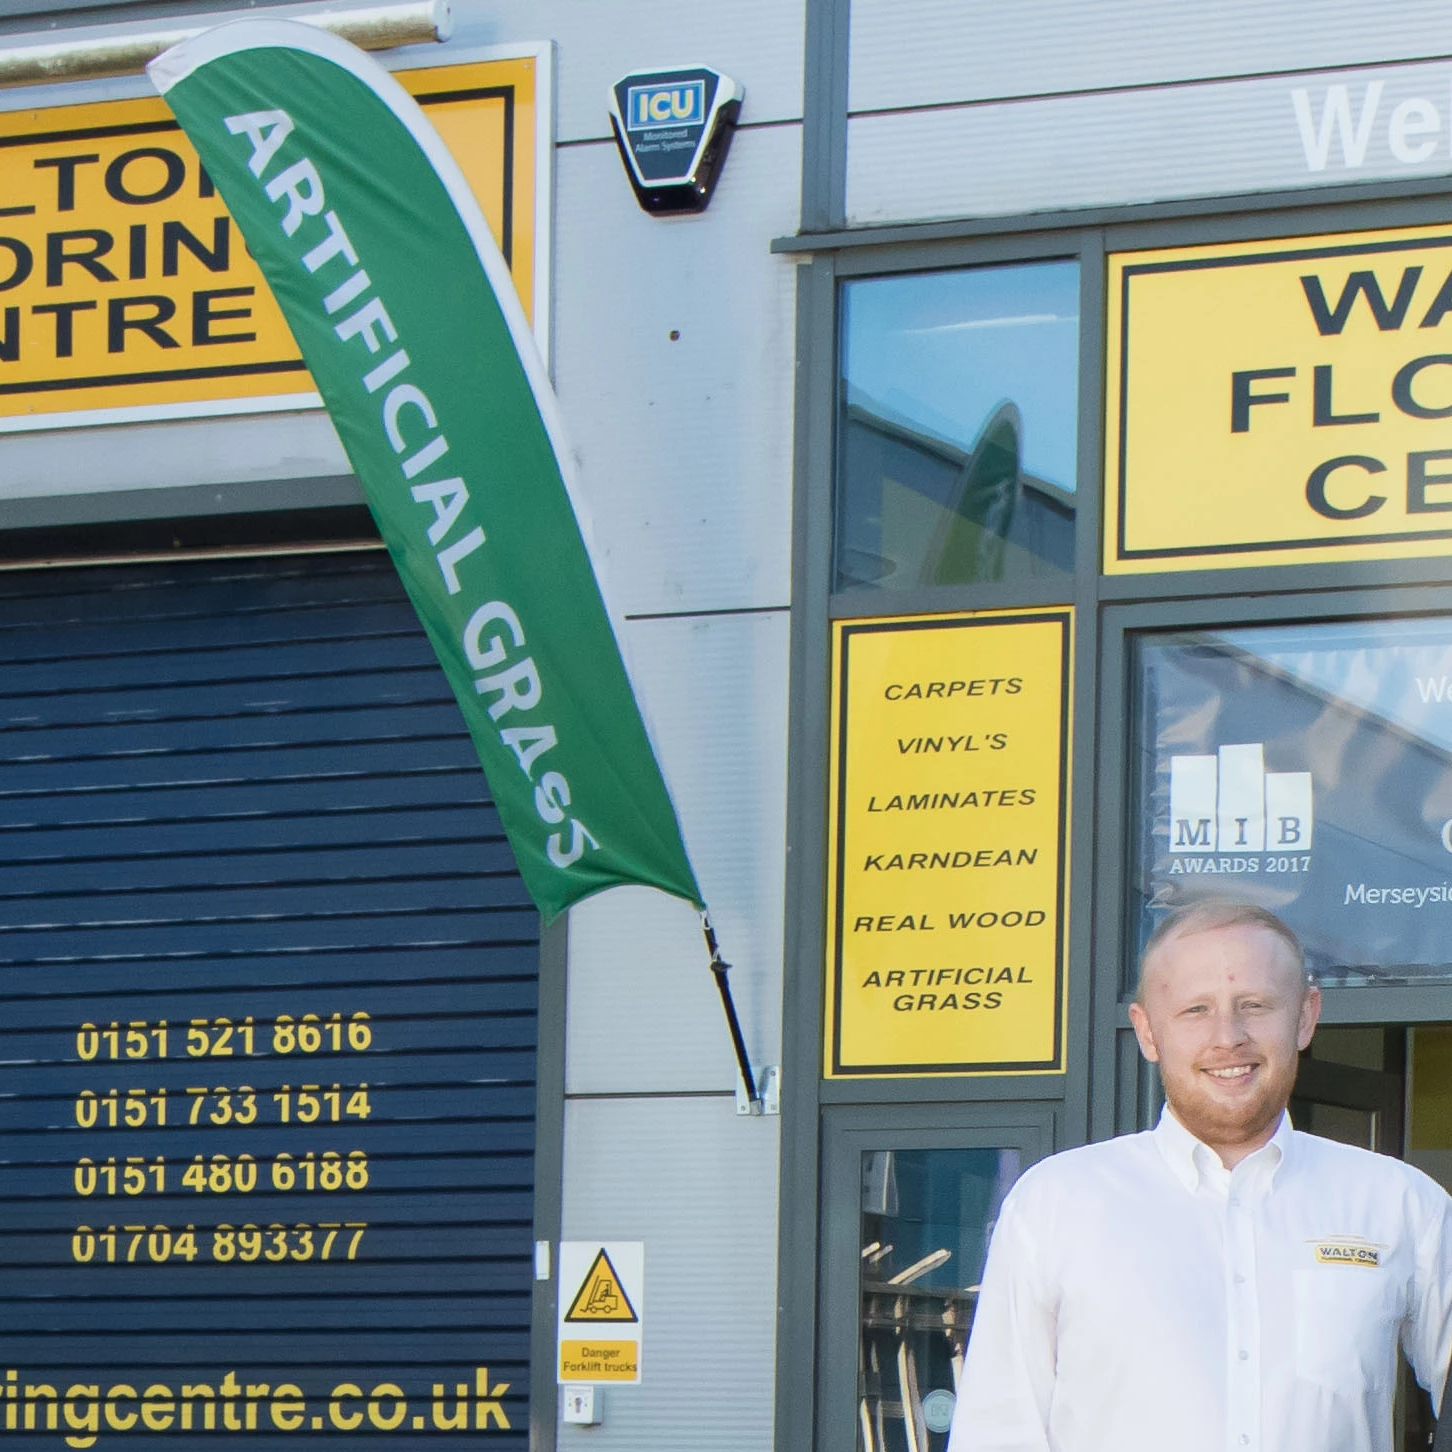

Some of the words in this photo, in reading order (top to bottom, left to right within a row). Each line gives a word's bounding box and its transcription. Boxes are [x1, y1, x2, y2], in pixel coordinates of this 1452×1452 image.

[639, 88, 694, 122] ICU
[636, 144, 660, 153] Alarm
[661, 141, 696, 153] Systems
[643, 129, 688, 141] Monitored
[224, 108, 487, 594] ARTIFICIAL
[463, 600, 602, 868] GRASS
[885, 677, 1023, 702] CARPETS
[897, 733, 1007, 755] VINYL'S
[868, 788, 1036, 813] LAMINATES
[864, 848, 1038, 872] KARNDEAN
[1169, 859, 1259, 875] AWARDS
[1266, 857, 1312, 873] 2017
[854, 916, 935, 933] REAL
[948, 909, 1046, 928] WOOD
[862, 966, 1033, 989] ARTIFICIAL
[893, 991, 1002, 1012] GRASS
[76, 1020, 167, 1060] 0151
[186, 1016, 254, 1056] 521
[273, 1011, 372, 1054] 8616
[75, 1088, 166, 1128] 0151
[186, 1085, 258, 1125] 733
[273, 1083, 371, 1122] 1514
[74, 1157, 165, 1195] 0151
[182, 1154, 258, 1193] 480
[271, 1150, 369, 1190] 6188
[72, 1224, 198, 1263] 01704
[212, 1222, 368, 1262] 893377
[1319, 1247, 1378, 1260] WALTON
[582, 1347, 620, 1360] Danger
[563, 1361, 601, 1373] Forklift
[604, 1360, 638, 1373] trucks
